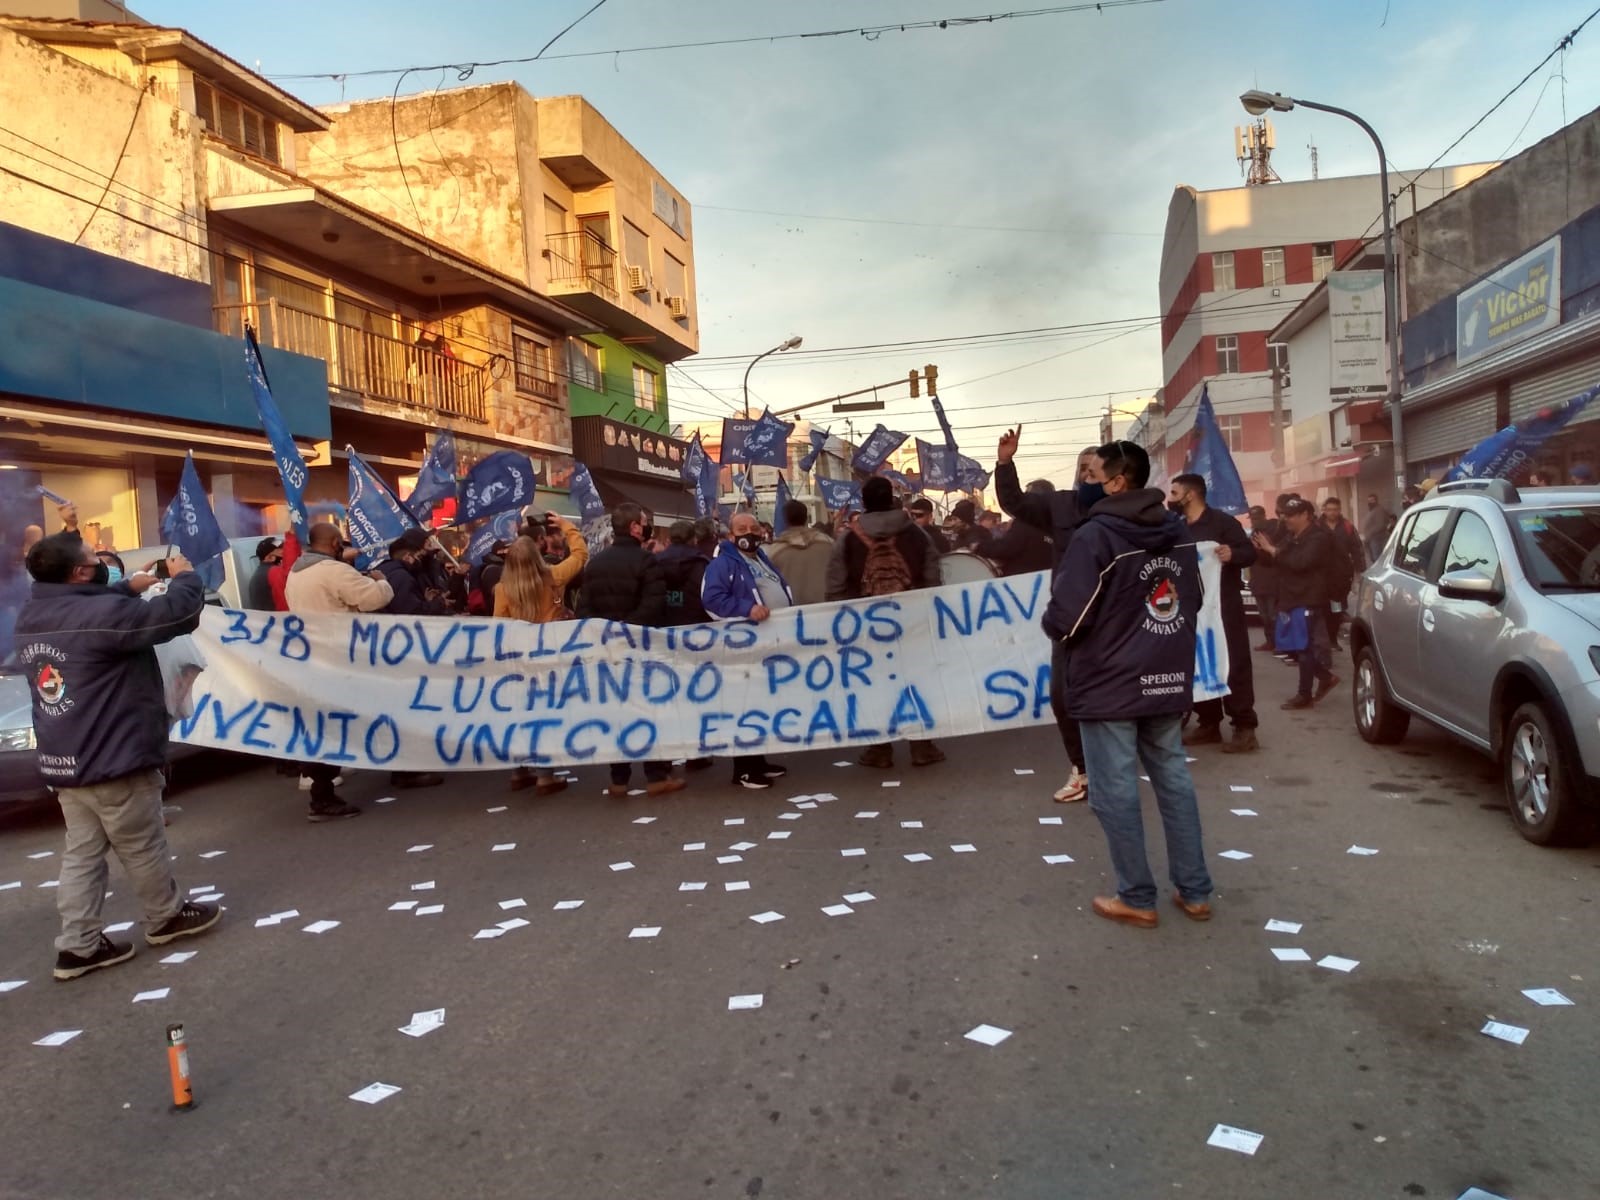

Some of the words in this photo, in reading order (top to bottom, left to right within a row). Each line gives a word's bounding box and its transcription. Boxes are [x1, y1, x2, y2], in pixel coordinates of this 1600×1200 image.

[1487, 274, 1551, 323] Victor
[1139, 557, 1183, 581] OBREROS
[221, 608, 311, 661] 3/8
[796, 600, 904, 646] LOS
[934, 572, 1043, 640] NAV
[1142, 615, 1186, 635] NAVALES
[409, 654, 723, 713] LUCHANDO
[763, 645, 900, 694] POR:
[1140, 671, 1185, 685] SPERONI
[170, 693, 401, 765] NVENIO
[435, 718, 658, 766] UNICO
[698, 684, 935, 751] ESCALA
[985, 667, 1053, 720] SA
